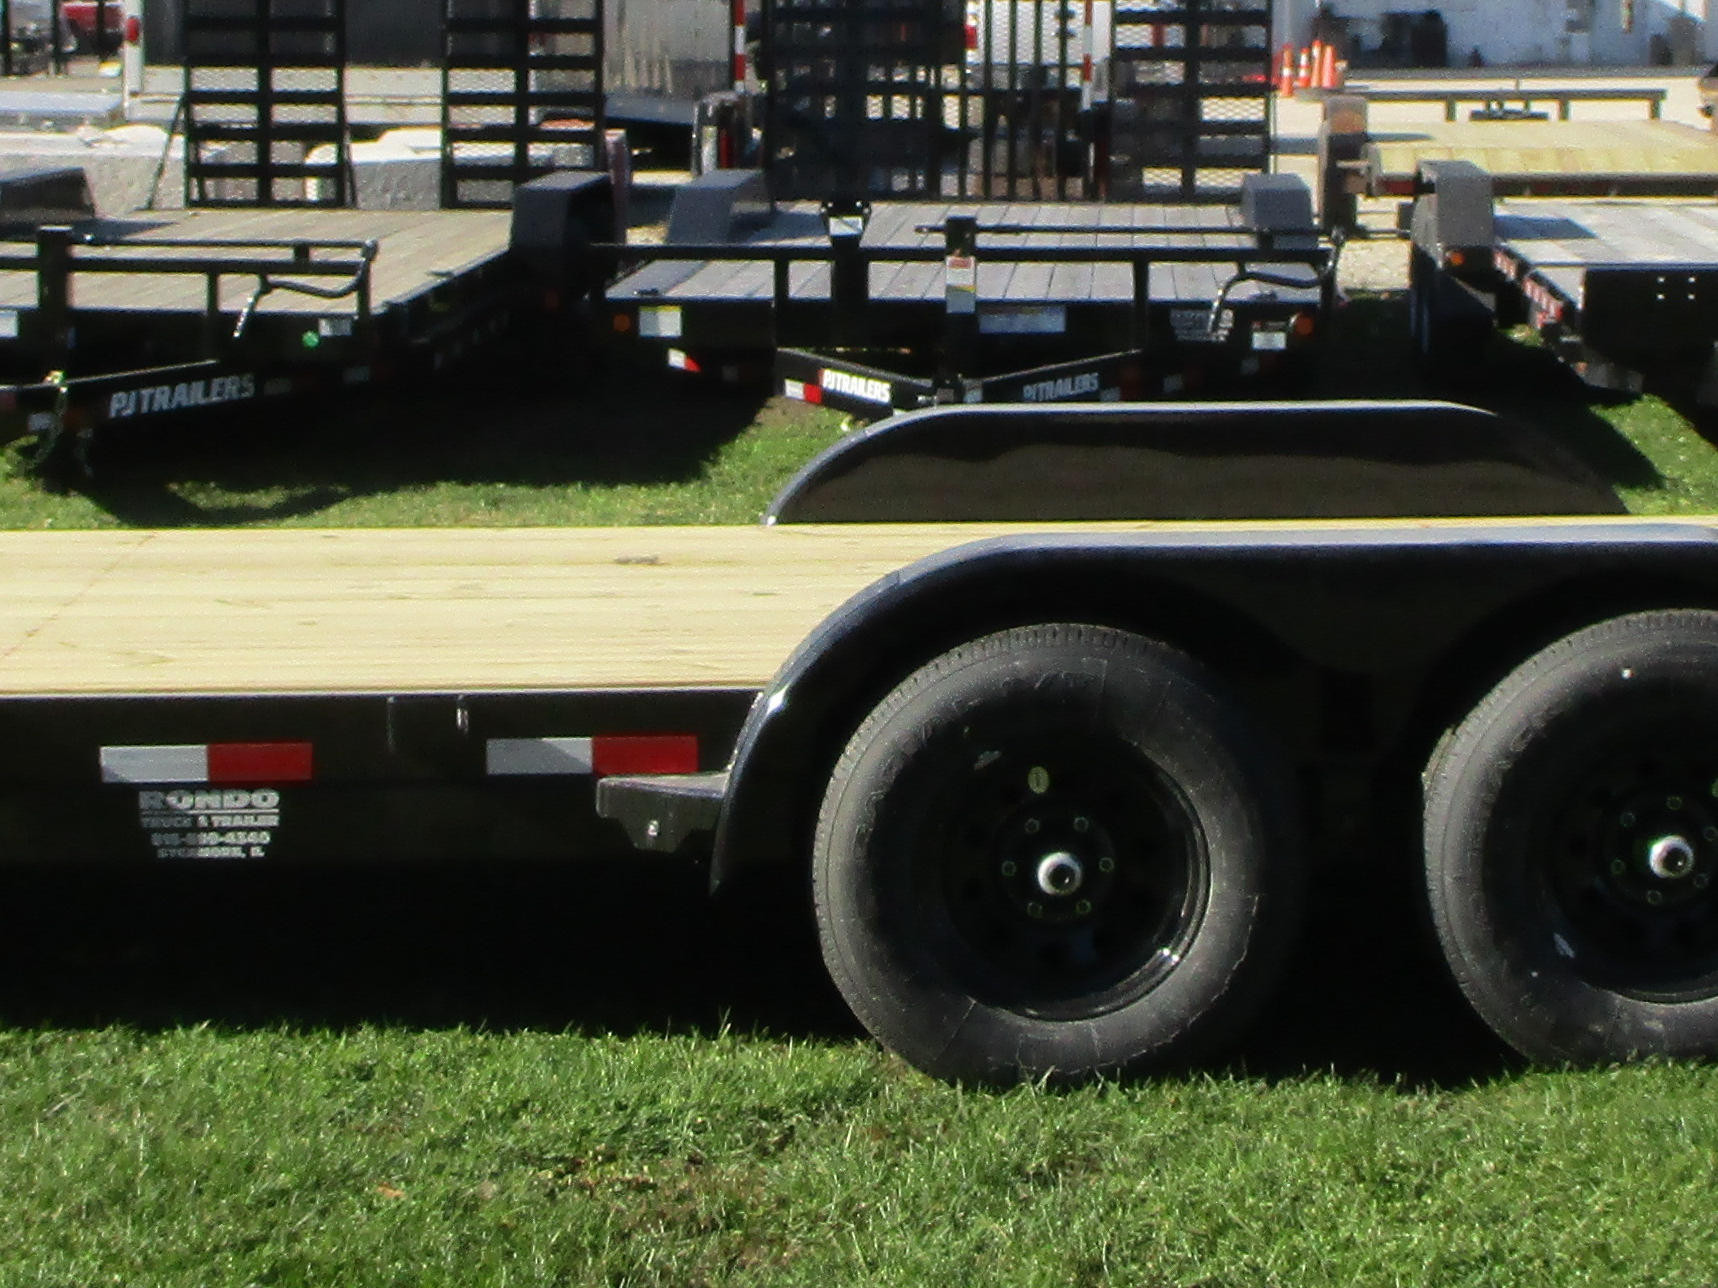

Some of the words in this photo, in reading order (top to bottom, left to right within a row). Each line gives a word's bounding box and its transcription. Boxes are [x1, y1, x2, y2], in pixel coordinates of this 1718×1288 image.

[107, 391, 137, 420] PJ
[138, 373, 256, 414] TRAILERS
[139, 788, 280, 810] RONDO
